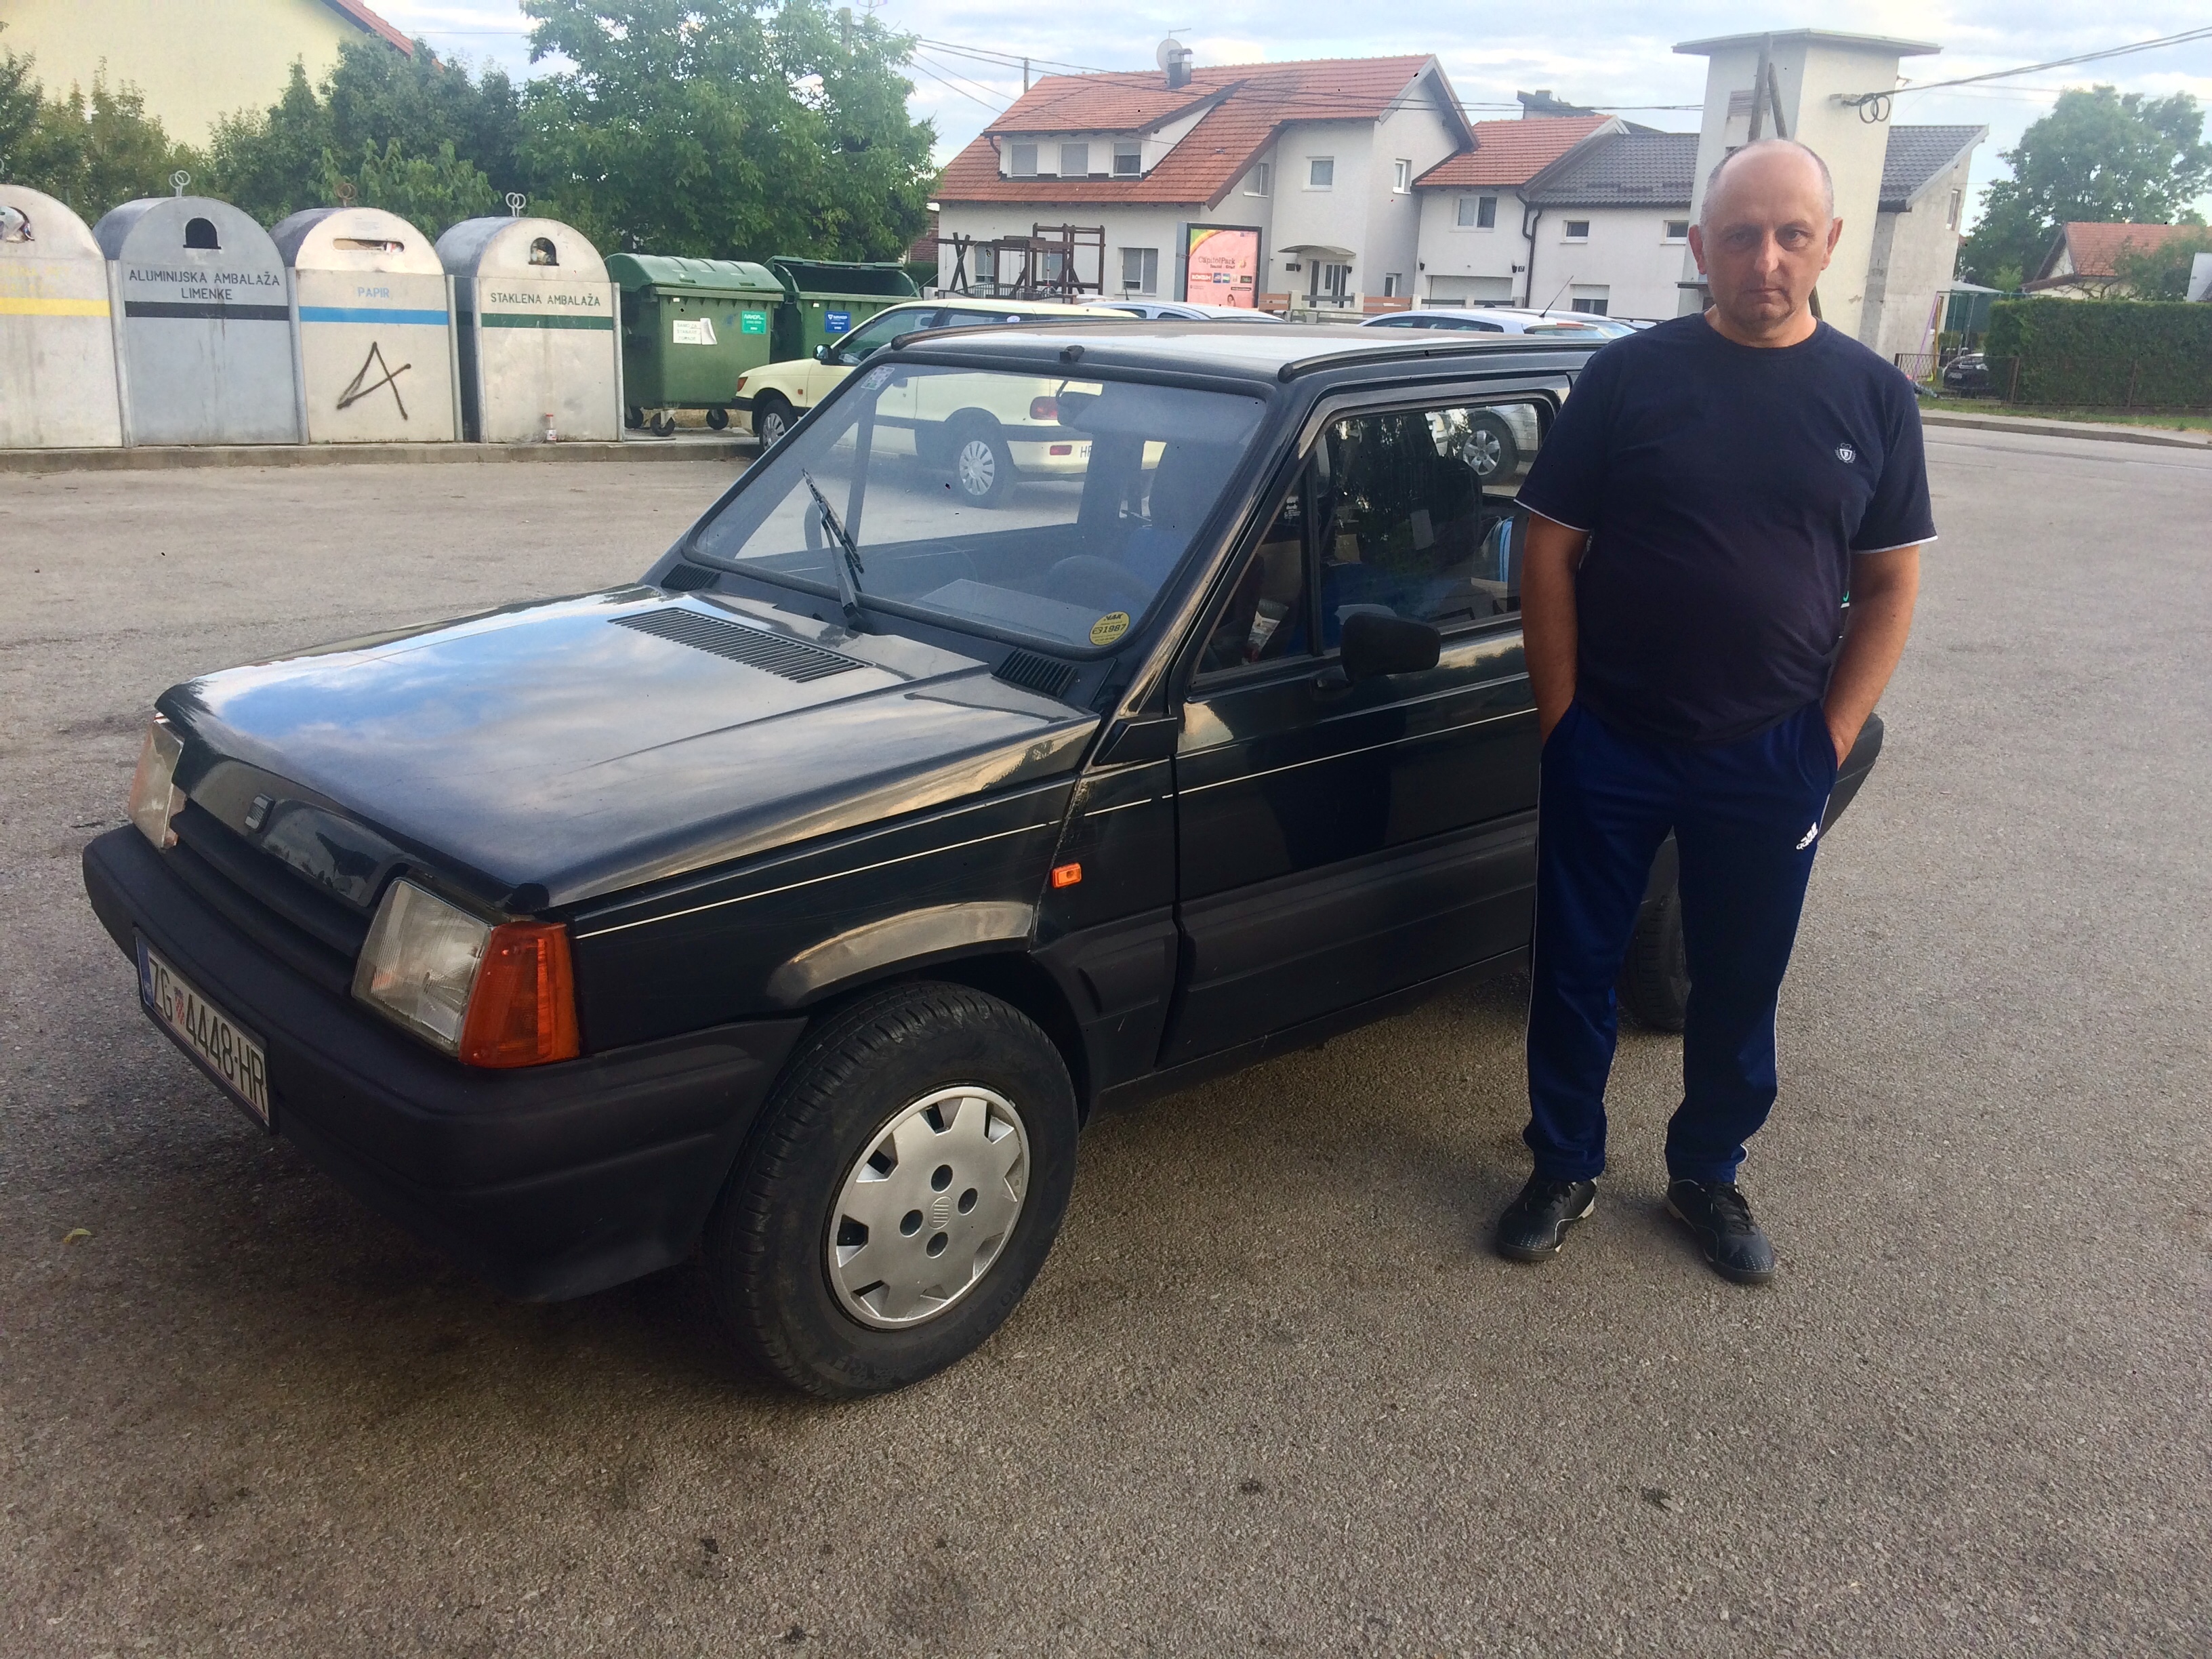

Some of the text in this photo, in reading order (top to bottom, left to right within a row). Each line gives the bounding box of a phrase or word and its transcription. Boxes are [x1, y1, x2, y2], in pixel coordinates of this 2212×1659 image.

[129, 270, 280, 286] ALUMINIJSKA AMBALAŽA
[181, 287, 232, 300] LIMENKE
[357, 287, 390, 298] PAPIR
[491, 292, 600, 306] STAKLENA AMBALAŽA
[1103, 623, 1127, 634] 1987
[149, 957, 173, 1023] ZG
